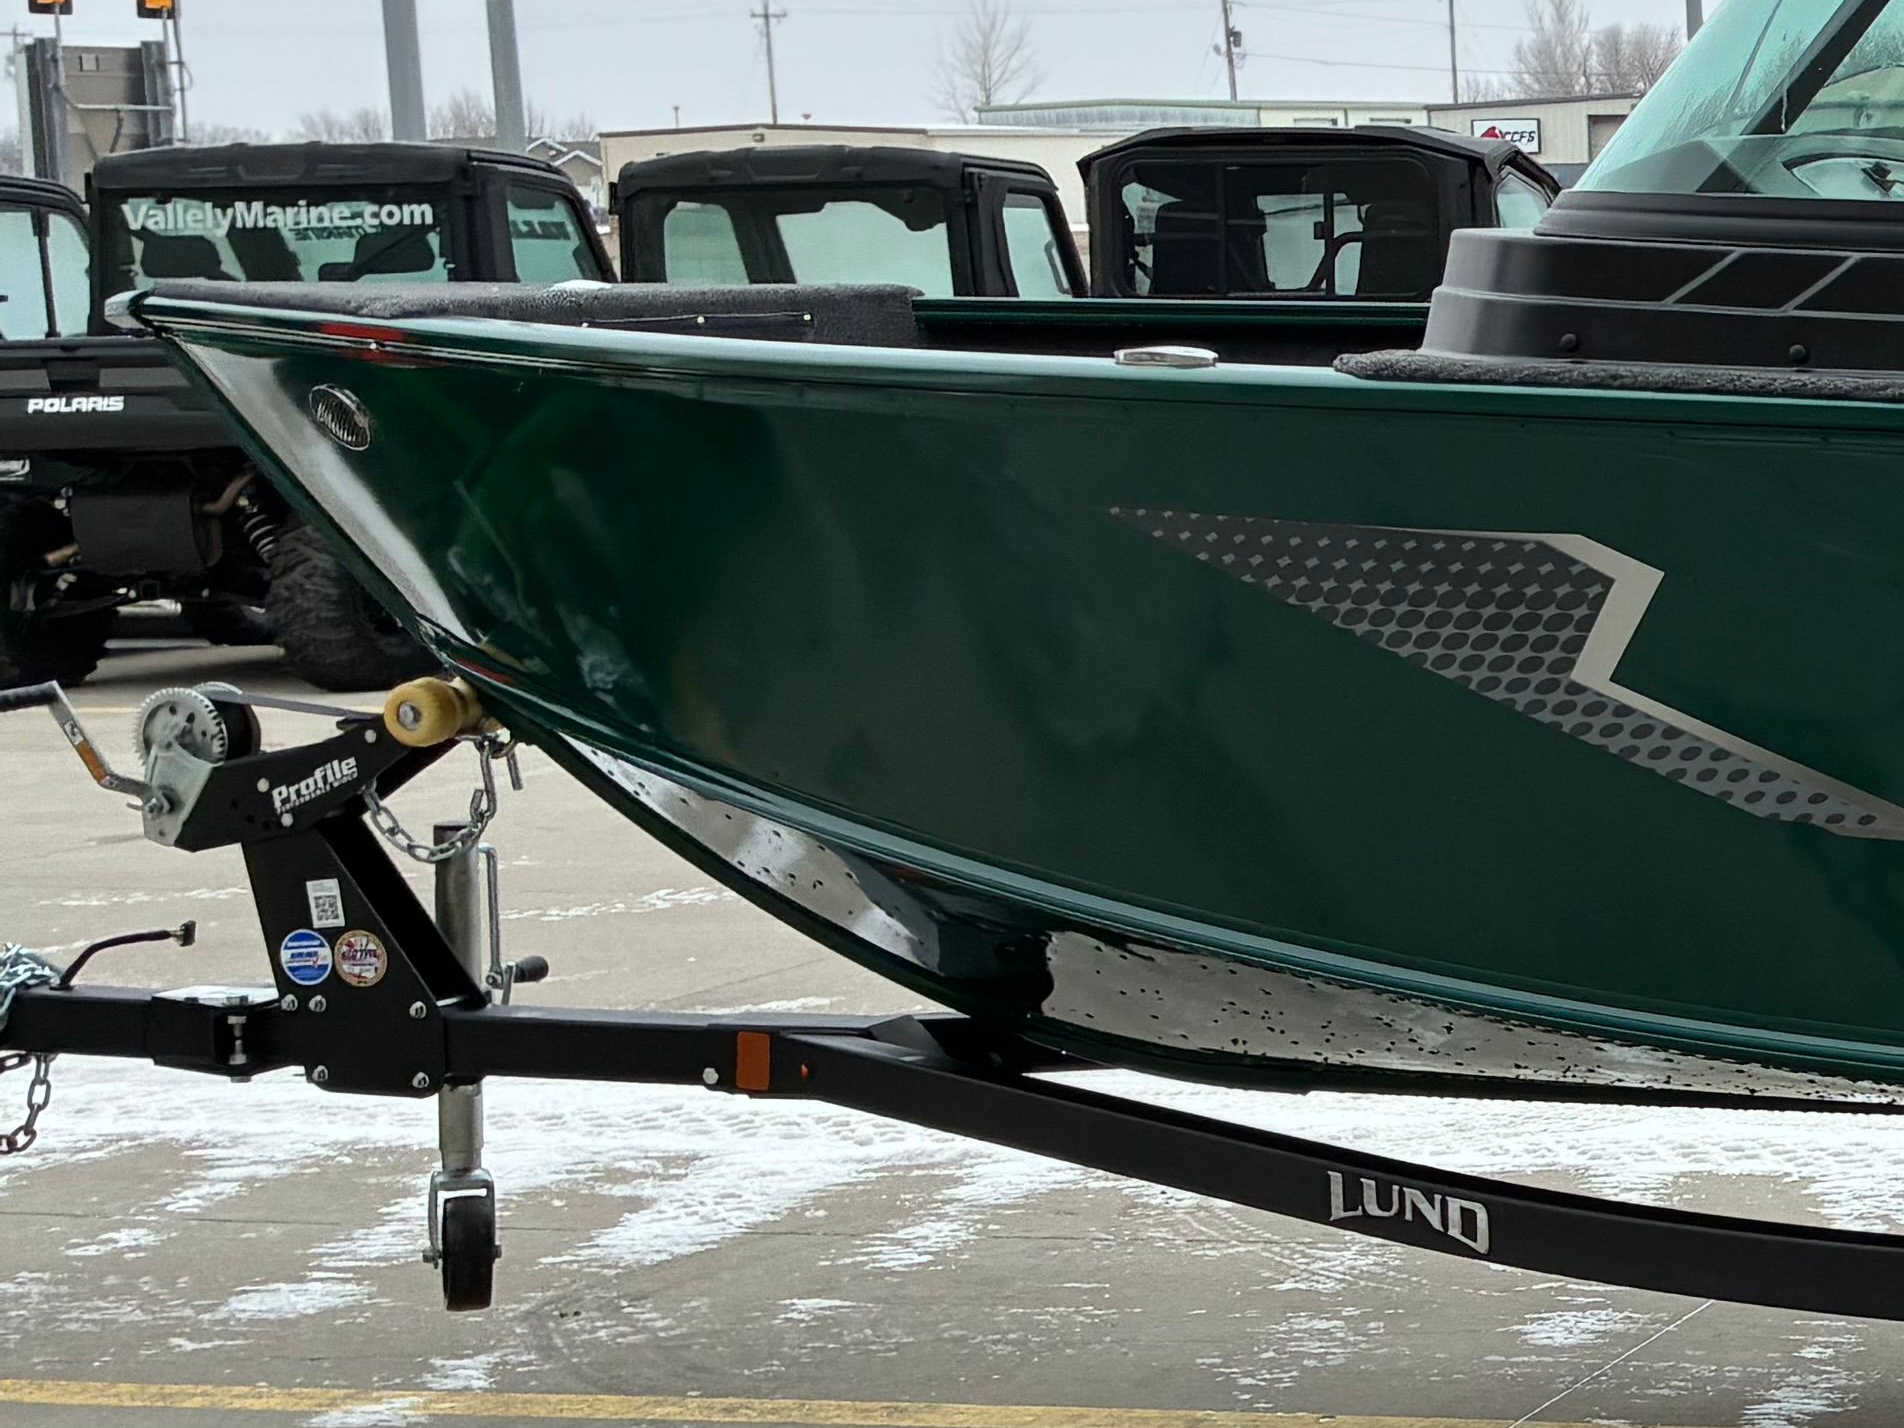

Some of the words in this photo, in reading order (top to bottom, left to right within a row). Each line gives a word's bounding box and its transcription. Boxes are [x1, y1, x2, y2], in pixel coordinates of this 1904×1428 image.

[121, 200, 434, 236] VallelyMarine.com
[27, 395, 125, 414] POLARIS
[271, 756, 357, 809] Profile
[1327, 1170, 1490, 1255] LUND
